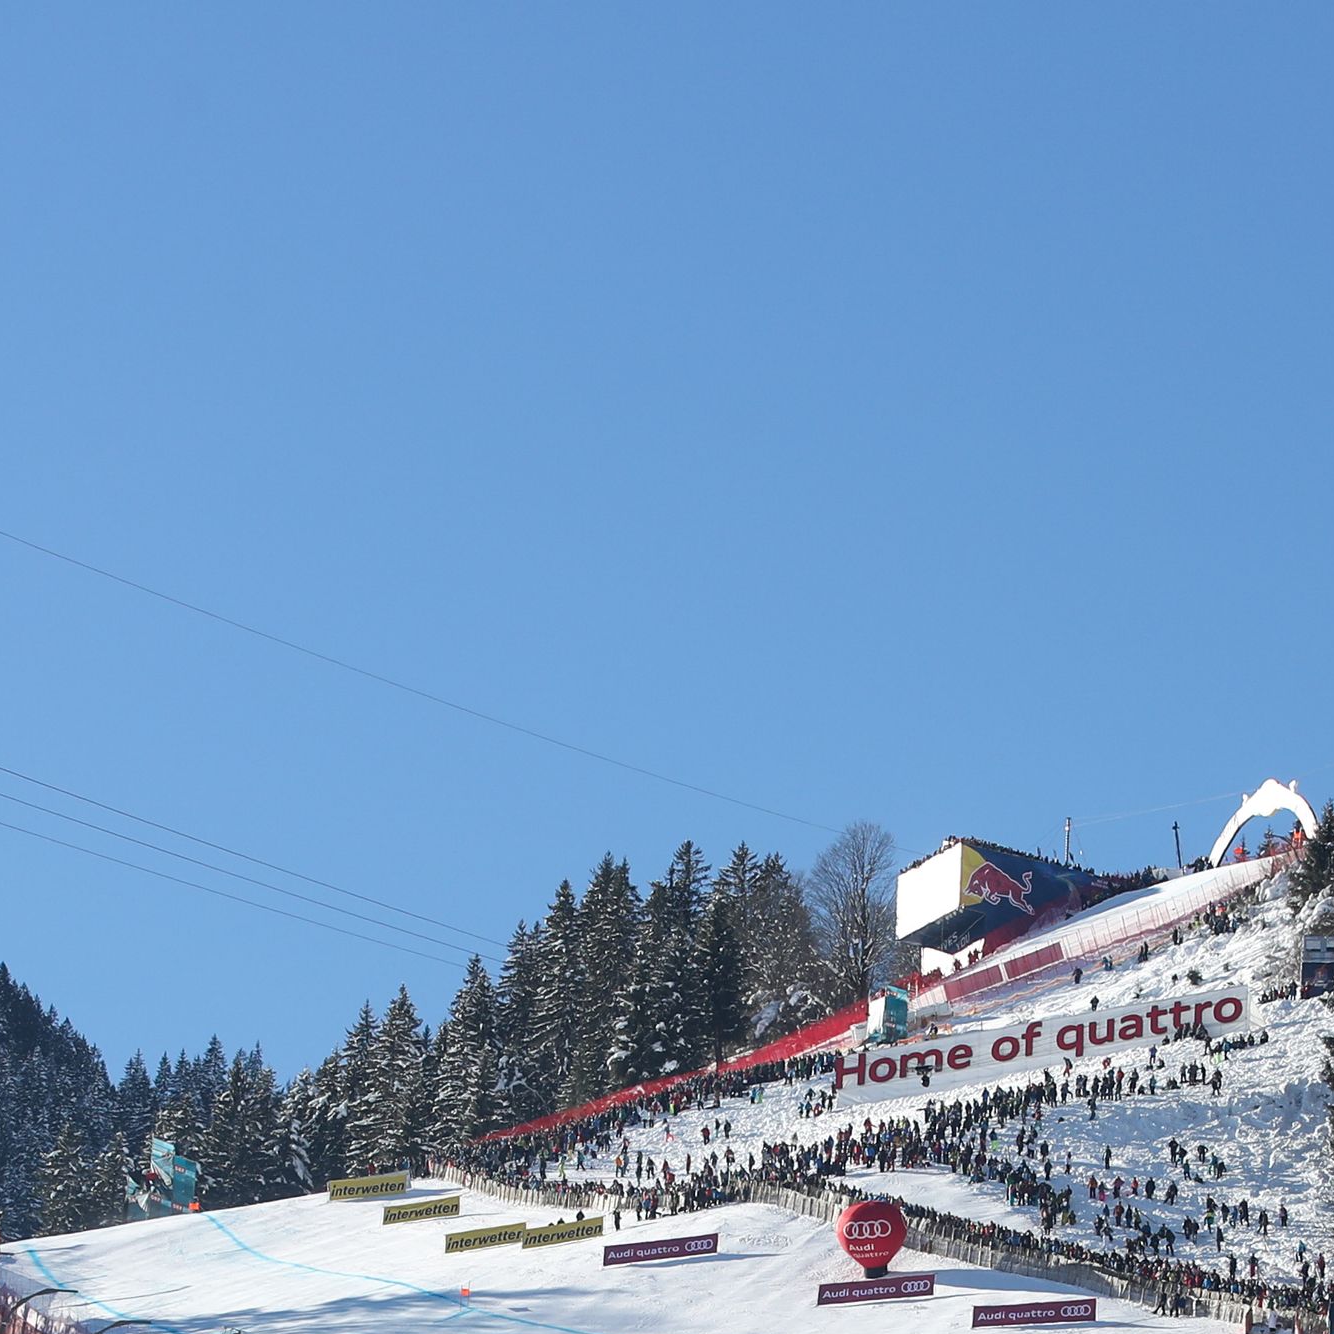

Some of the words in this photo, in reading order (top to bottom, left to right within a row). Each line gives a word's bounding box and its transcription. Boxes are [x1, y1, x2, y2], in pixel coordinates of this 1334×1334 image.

[834, 1043, 973, 1090] Home
[991, 1020, 1044, 1062] of
[1056, 996, 1244, 1057] quattro
[330, 1182, 405, 1197] interwetten
[386, 1203, 458, 1222] interwetten
[523, 1224, 603, 1246] interwetten
[608, 1248, 634, 1259] Audi
[636, 1245, 680, 1257] quattro
[848, 1243, 875, 1251] Audi
[822, 1288, 849, 1299] Audi
[852, 1286, 896, 1297] quattro
[977, 1311, 1005, 1321] Audi
[1008, 1309, 1056, 1320] quattro
